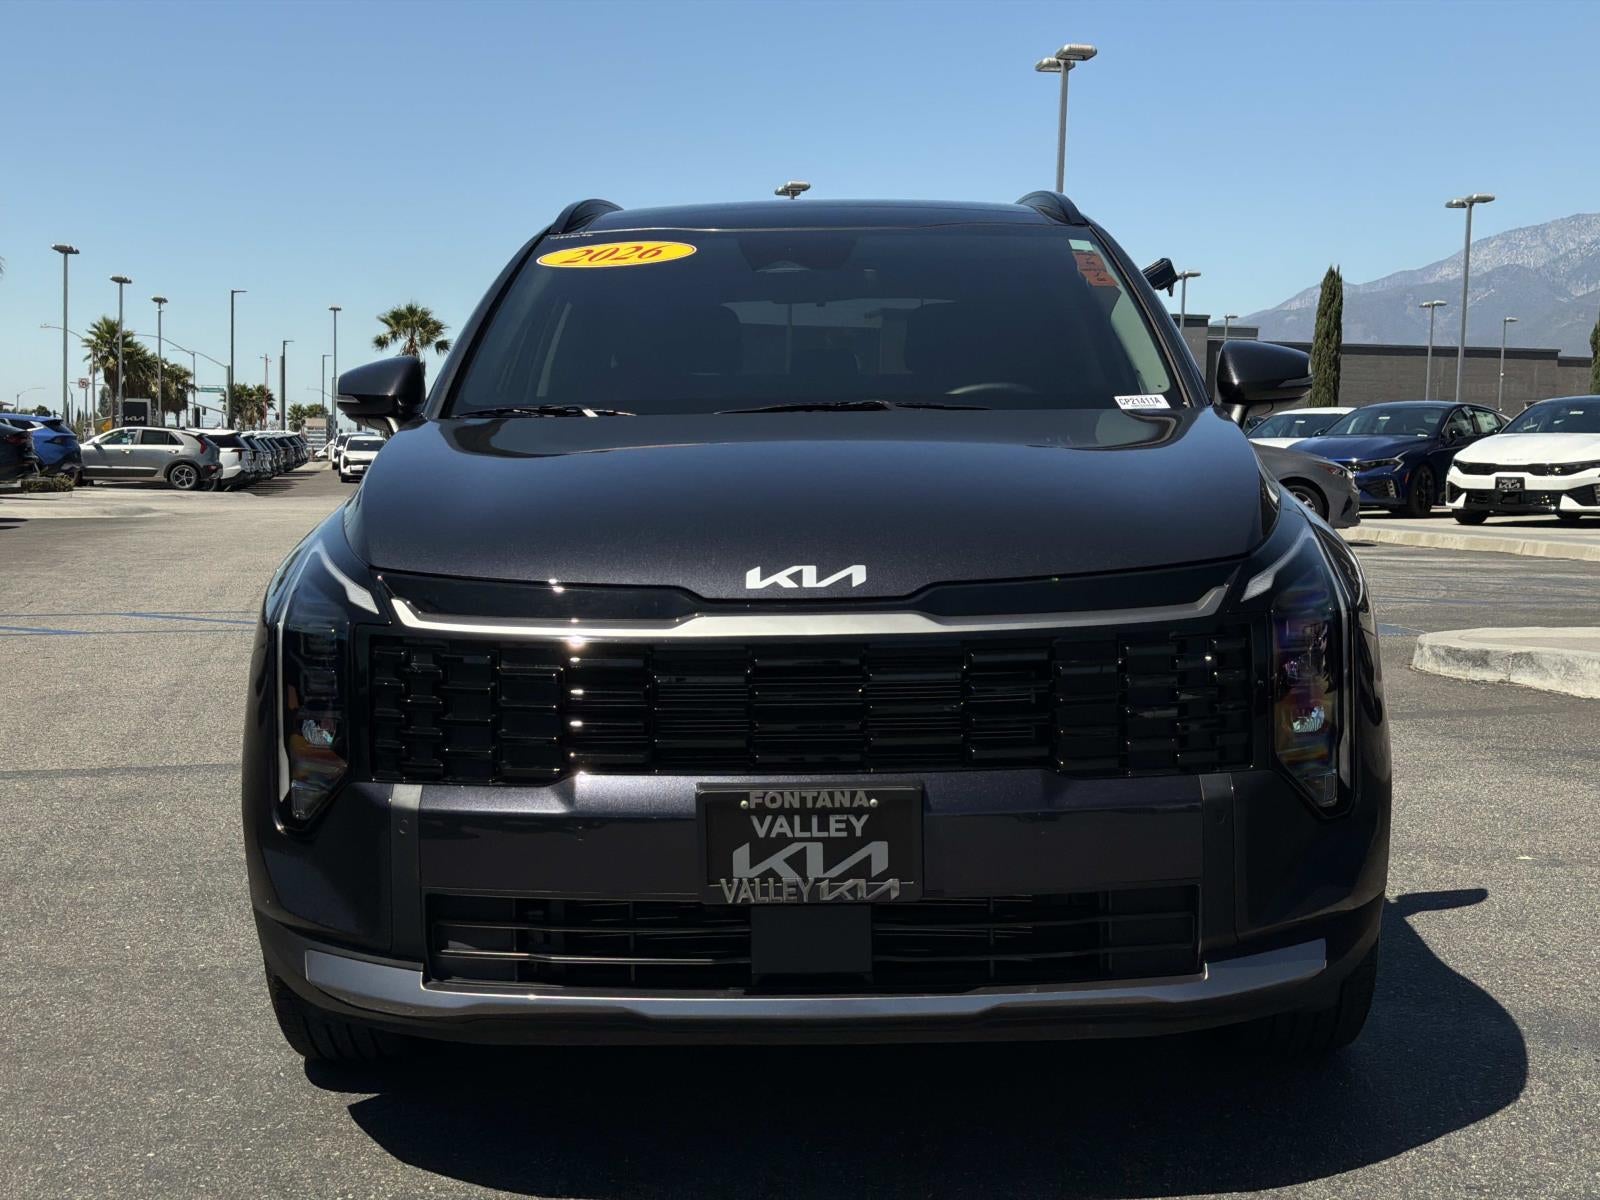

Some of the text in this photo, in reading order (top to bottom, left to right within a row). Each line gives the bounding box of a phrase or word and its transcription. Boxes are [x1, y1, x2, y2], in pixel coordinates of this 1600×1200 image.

[559, 245, 670, 263] 2026
[746, 565, 866, 589] KIA
[750, 790, 869, 809] FONTANA
[751, 814, 869, 838] VALLEY
[733, 841, 888, 878] KIA
[720, 877, 900, 903] VALLEY KIA
